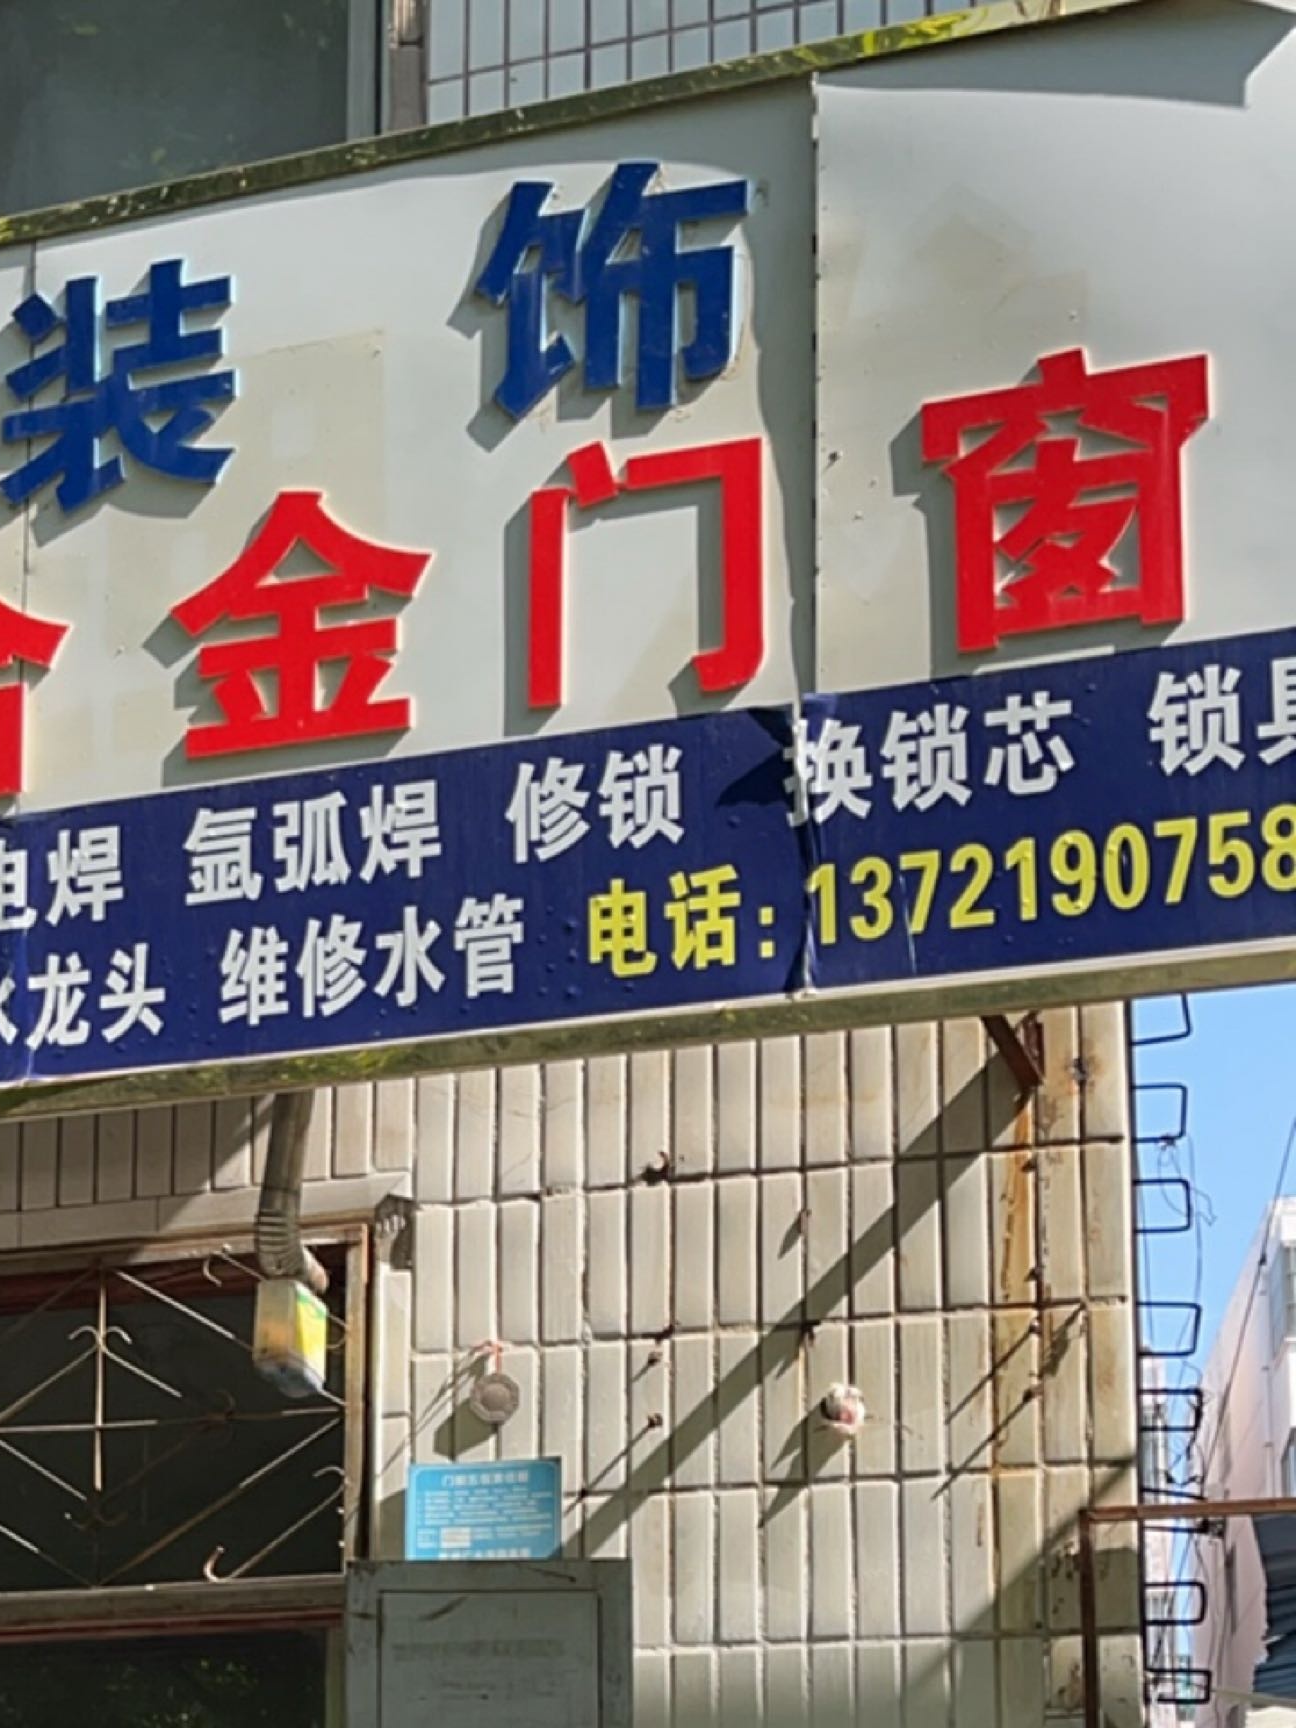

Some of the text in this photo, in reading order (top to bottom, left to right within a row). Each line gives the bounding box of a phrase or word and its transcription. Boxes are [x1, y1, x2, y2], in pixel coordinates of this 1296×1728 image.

[183, 779, 442, 906] 氩弧焊
[505, 743, 685, 864] 修锁
[783, 691, 1075, 827] 换锁芯
[219, 893, 525, 1026] 维修水管
